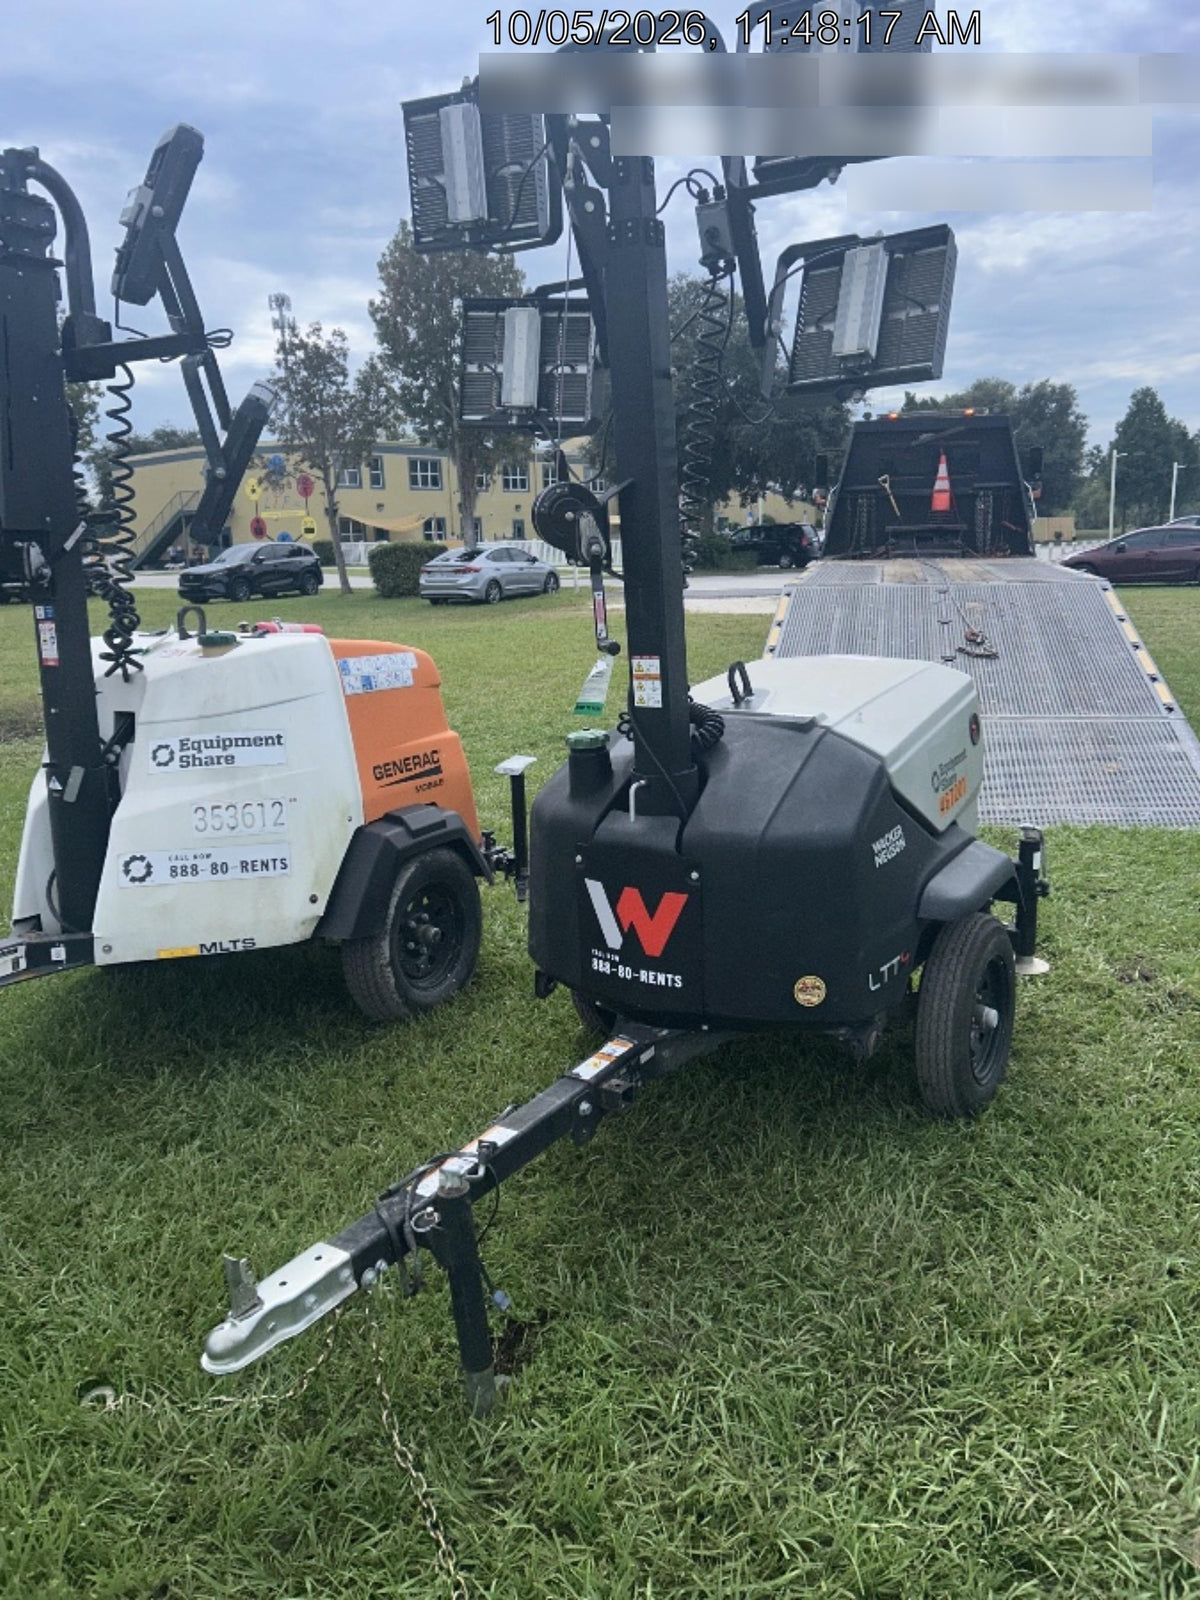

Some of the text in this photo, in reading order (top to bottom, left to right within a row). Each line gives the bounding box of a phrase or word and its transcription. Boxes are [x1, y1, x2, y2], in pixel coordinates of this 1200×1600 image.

[178, 733, 284, 754] Equipment
[178, 753, 236, 769] Share
[372, 749, 440, 781] GENERAC
[193, 801, 285, 833] 353612
[168, 852, 213, 862] CALL NOW
